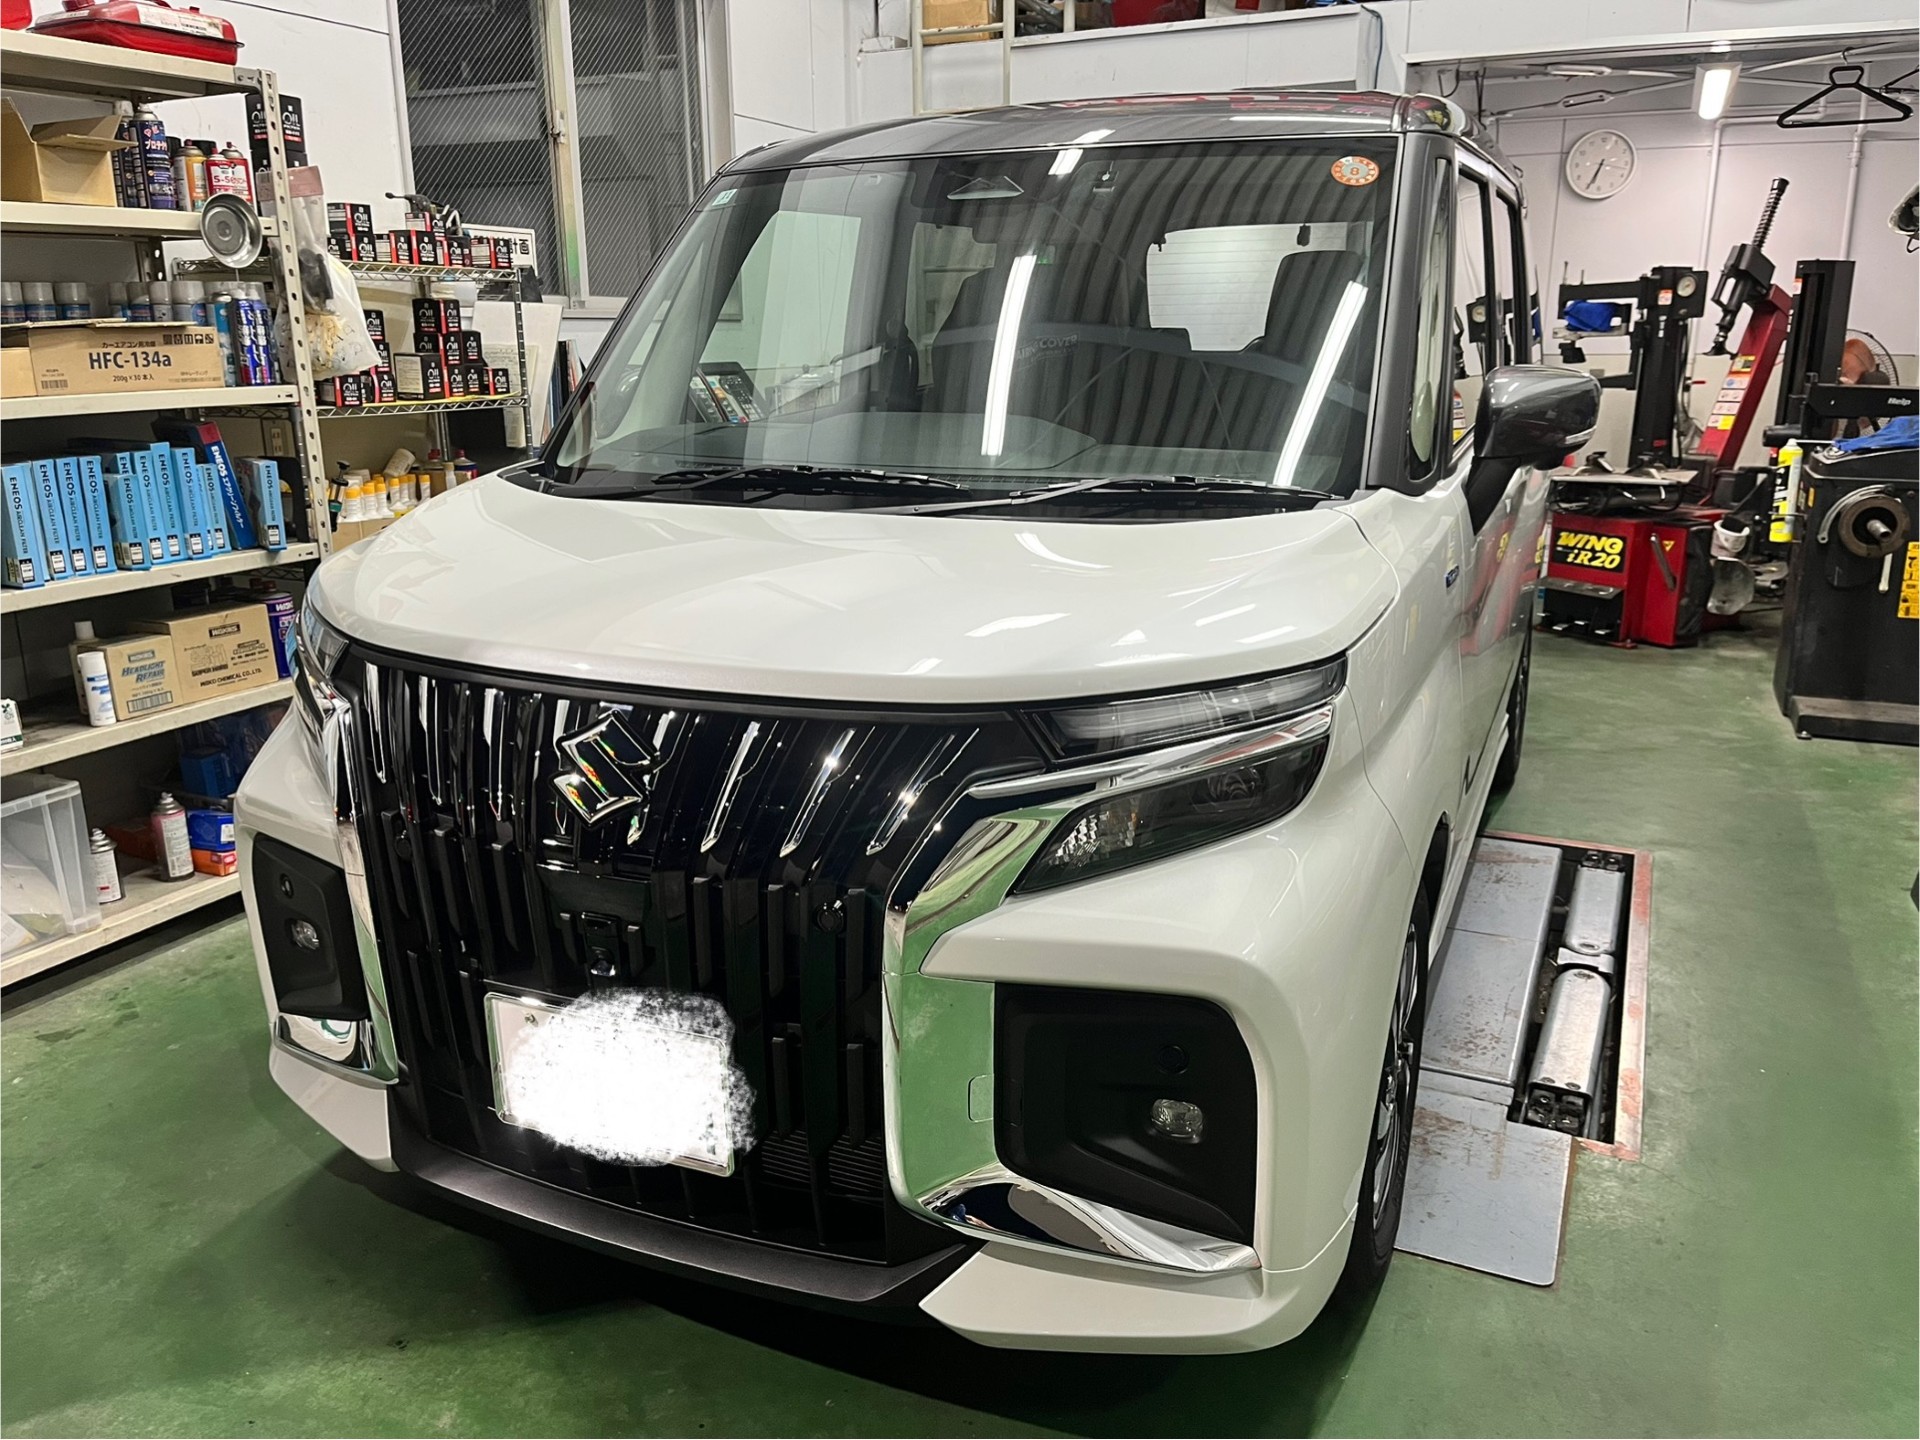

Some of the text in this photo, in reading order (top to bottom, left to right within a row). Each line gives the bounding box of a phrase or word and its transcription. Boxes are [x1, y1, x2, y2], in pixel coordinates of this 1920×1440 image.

[1350, 167, 1360, 176] 8
[88, 351, 172, 370] HFC-134a
[120, 456, 129, 474] ENE
[140, 456, 152, 488] ENEOS
[158, 454, 170, 486] ENEOS
[182, 452, 194, 484] ENEOS
[211, 446, 228, 478] ENEOS
[40, 464, 53, 499] ENEOS
[64, 462, 76, 496] ENEOS
[87, 460, 98, 494] ENEOS
[205, 468, 215, 492] ENEOS
[266, 466, 274, 490] ENEOS
[10, 477, 22, 510] ENEOS
[124, 478, 134, 504] ENEOS
[1557, 532, 1624, 554] WING
[122, 660, 166, 676] HEADLIGHT
[136, 668, 165, 683] REPAIR
[218, 673, 242, 683] CHEMICAL
